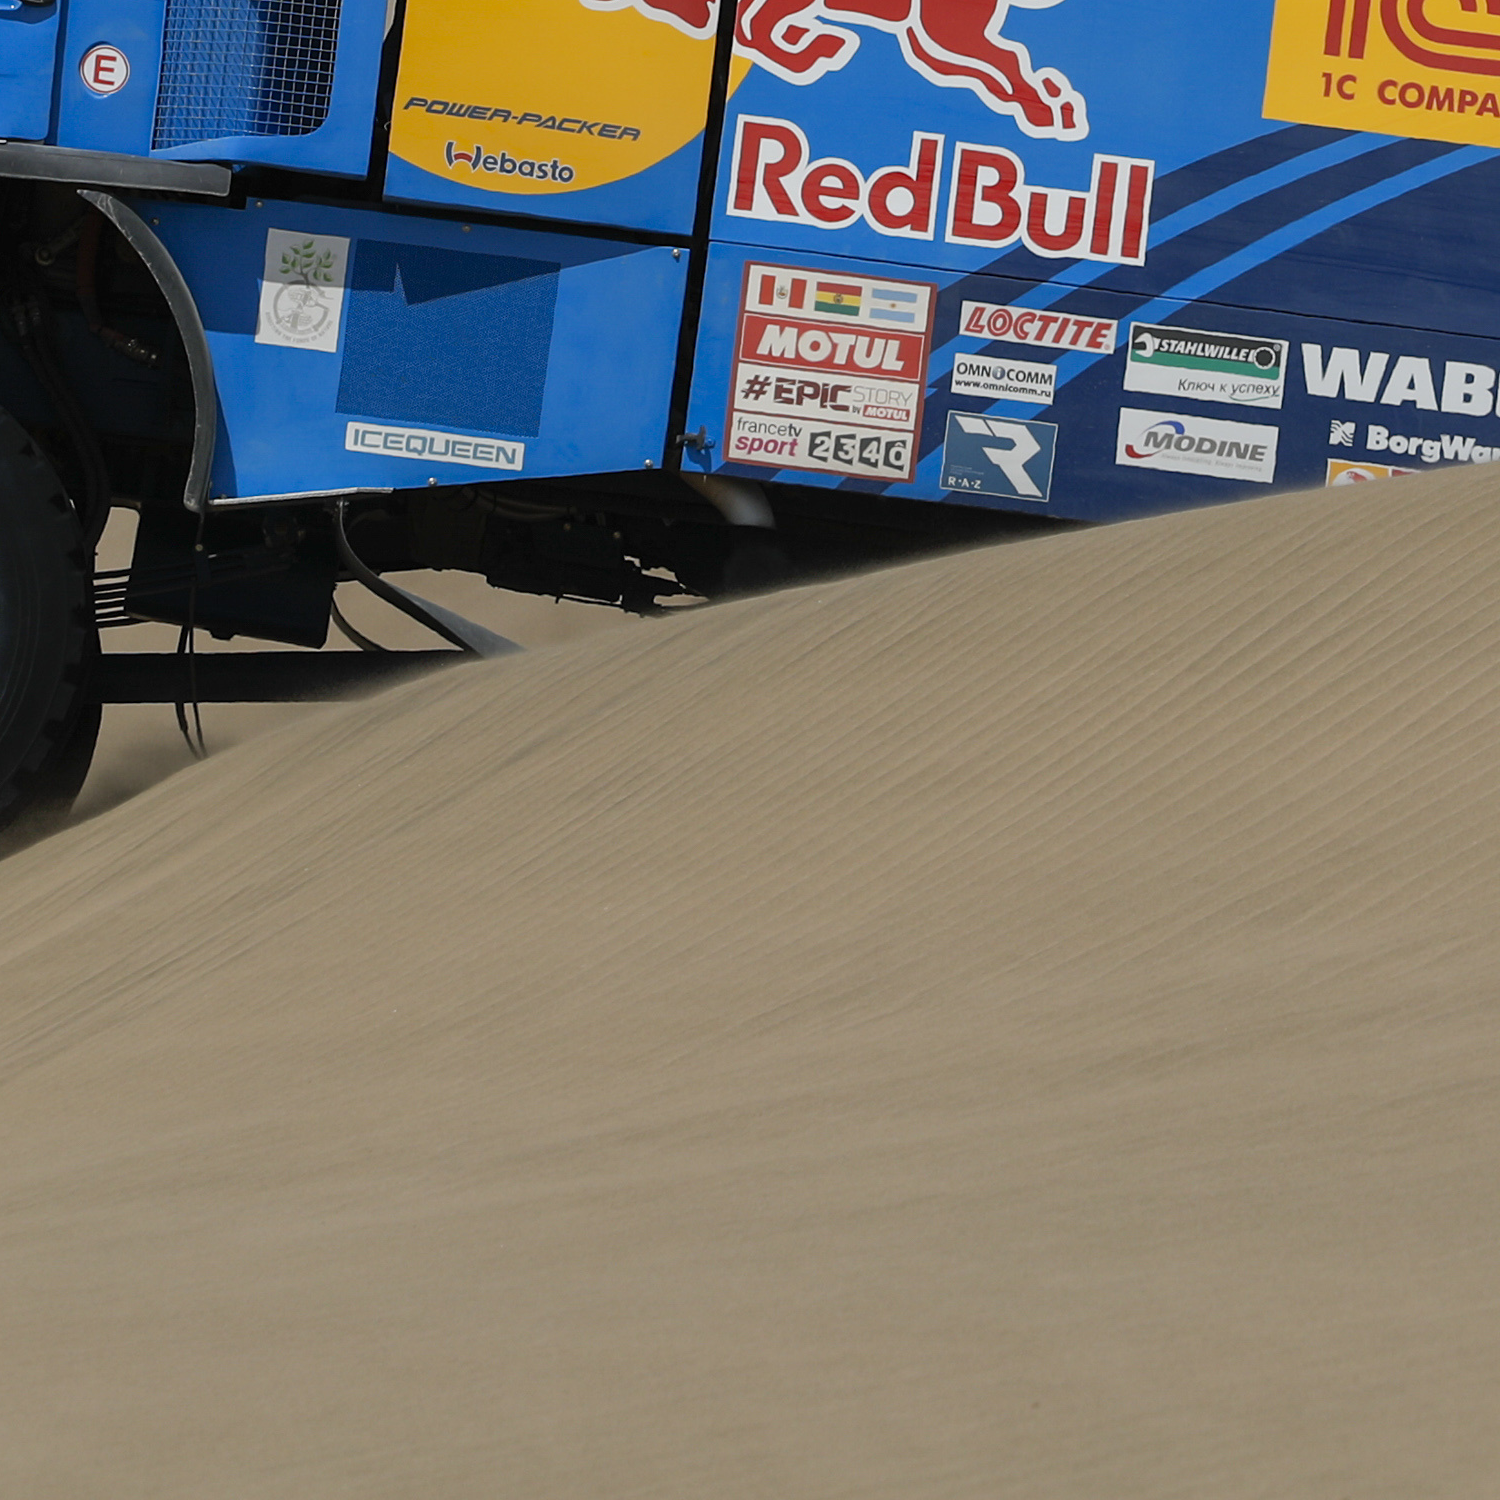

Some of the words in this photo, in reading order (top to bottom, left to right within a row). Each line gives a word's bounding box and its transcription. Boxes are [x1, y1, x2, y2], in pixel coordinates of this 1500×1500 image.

[403, 96, 642, 141] POWER-PACKER
[445, 141, 575, 184] Webasto
[964, 306, 1113, 349] LOCTITE
[756, 324, 905, 371] MOTUL
[1160, 338, 1249, 362] STAHLWILLE
[955, 379, 1052, 398] www.omnicomm.ru
[1178, 378, 1215, 392] Ключ
[1219, 383, 1227, 393] к
[1230, 383, 1281, 396] успеху
[864, 406, 908, 421] MOTUL
[353, 429, 517, 464] ICEQUEEN
[735, 435, 798, 457] sport
[1143, 431, 1268, 462] MODINE
